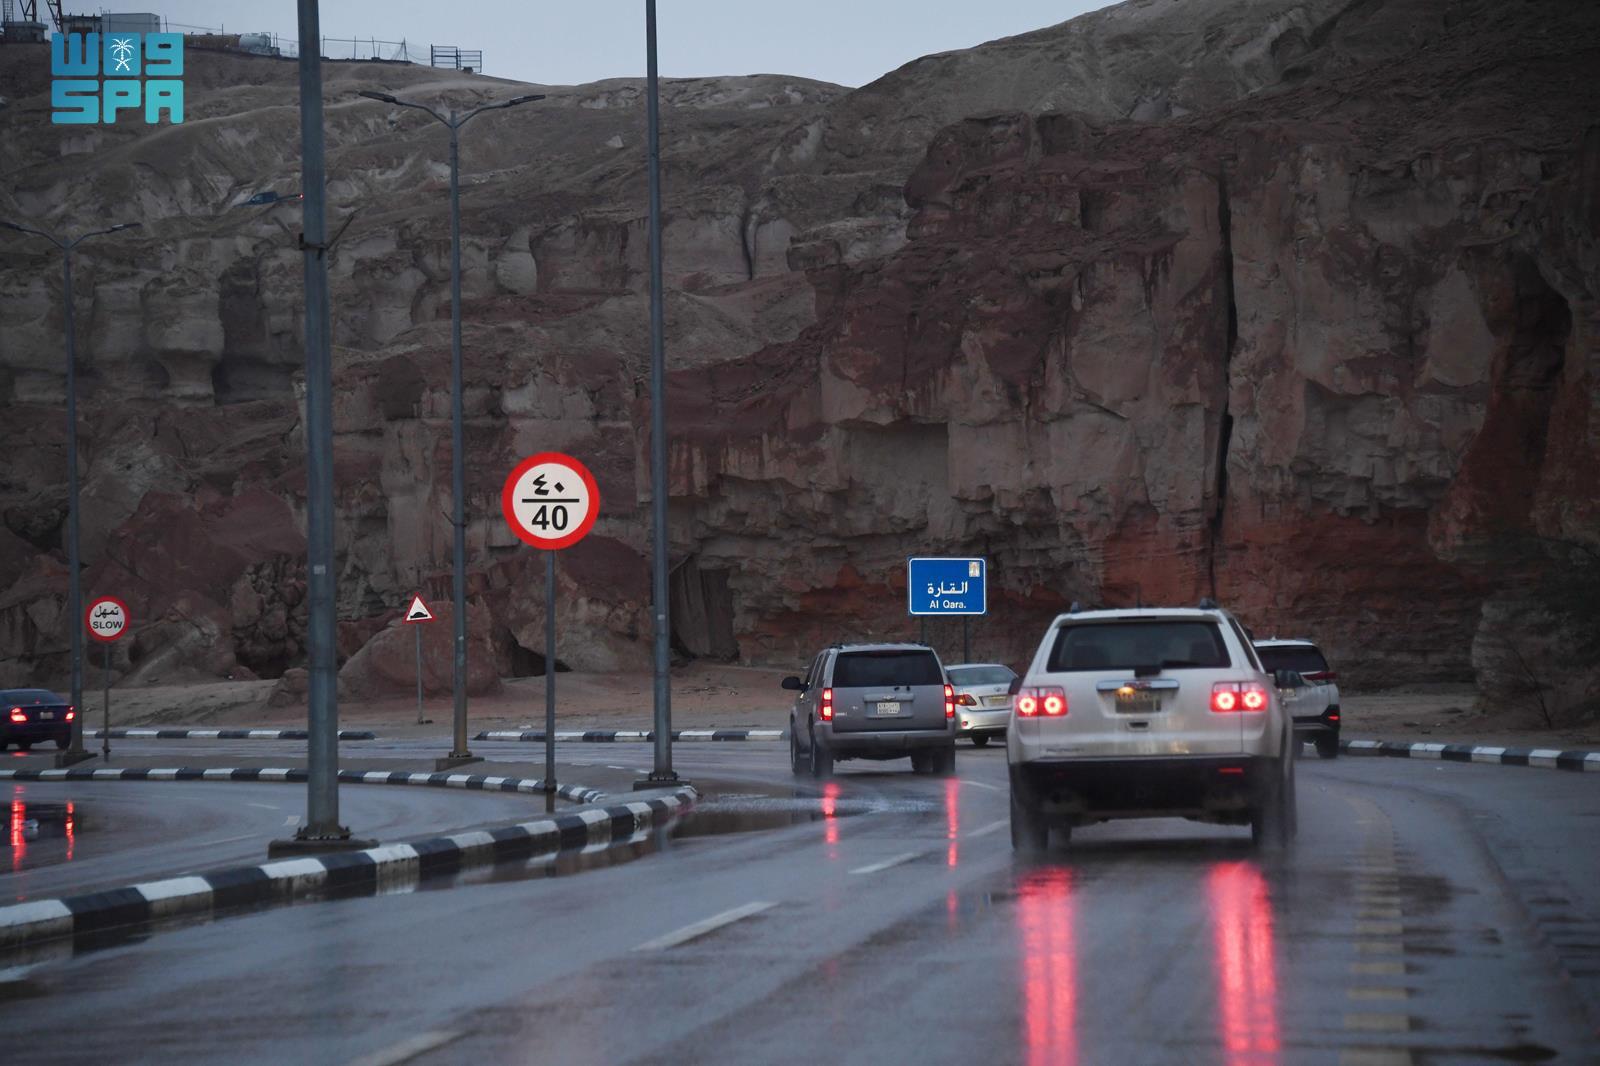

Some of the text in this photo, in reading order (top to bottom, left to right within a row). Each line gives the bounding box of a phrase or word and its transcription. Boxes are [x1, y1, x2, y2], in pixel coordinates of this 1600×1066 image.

[532, 473, 565, 496] ٤٠
[531, 504, 568, 531] 40
[927, 580, 968, 597] القارة
[929, 600, 967, 609] Al Qara.
[94, 606, 119, 618] تمهل
[92, 621, 122, 629] SLOW
